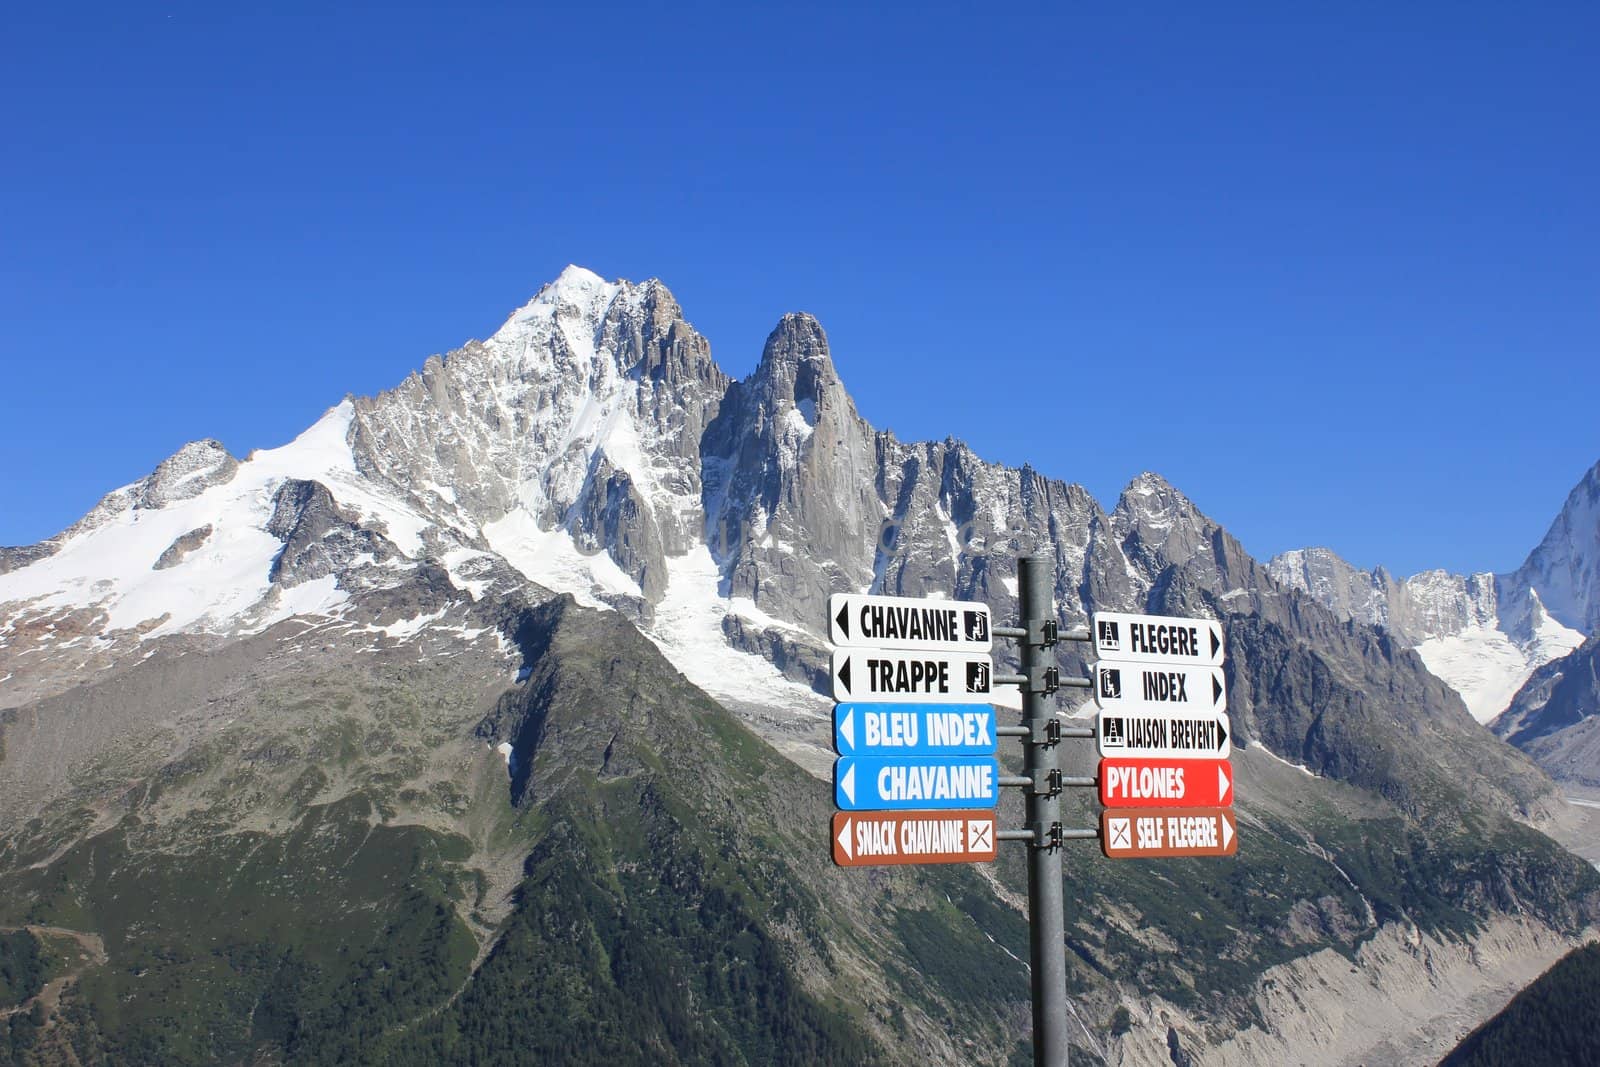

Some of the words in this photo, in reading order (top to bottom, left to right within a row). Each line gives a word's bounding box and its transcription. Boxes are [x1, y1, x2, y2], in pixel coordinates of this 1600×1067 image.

[860, 604, 958, 642] CHAVANNE
[1130, 622, 1198, 656] FLEGERE
[867, 659, 949, 693] TRAPPE
[1142, 671, 1188, 702] INDEX
[864, 712, 918, 747] BLEU
[926, 712, 992, 747] INDEX
[1126, 718, 1167, 749] LIAISON
[1171, 719, 1215, 750] BREVENT
[877, 765, 993, 801] CHAVANNE
[1107, 766, 1185, 799] PYLONES
[856, 820, 897, 856] SNACK
[900, 819, 964, 855] CHAVANNE
[1136, 817, 1164, 849] SELF
[1167, 816, 1218, 849] FLEGERE
